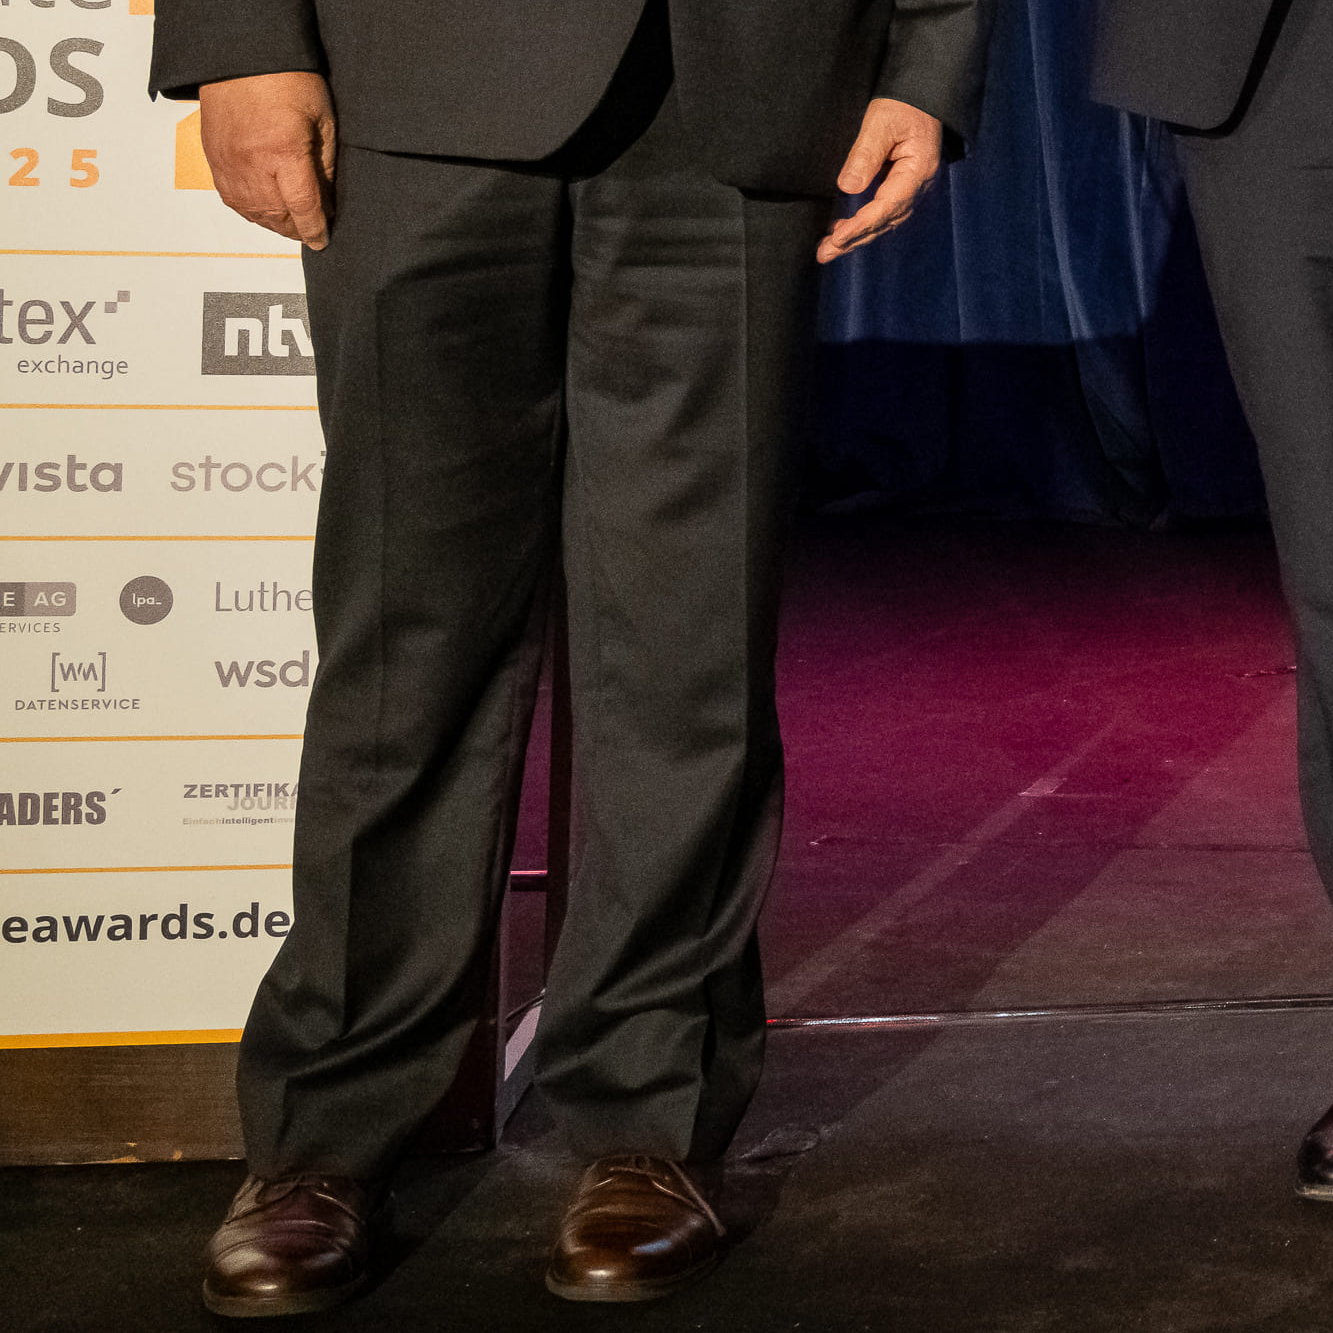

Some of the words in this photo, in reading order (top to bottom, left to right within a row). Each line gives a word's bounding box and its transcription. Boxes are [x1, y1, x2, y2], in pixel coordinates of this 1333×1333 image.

[17, 354, 129, 380] exchange
[170, 450, 327, 493] stock
[33, 591, 67, 607] AG
[215, 581, 314, 612] Luthe
[214, 650, 310, 689] wsd
[15, 698, 141, 711] DATENSERVICE
[1, 902, 291, 944] eawards.de
